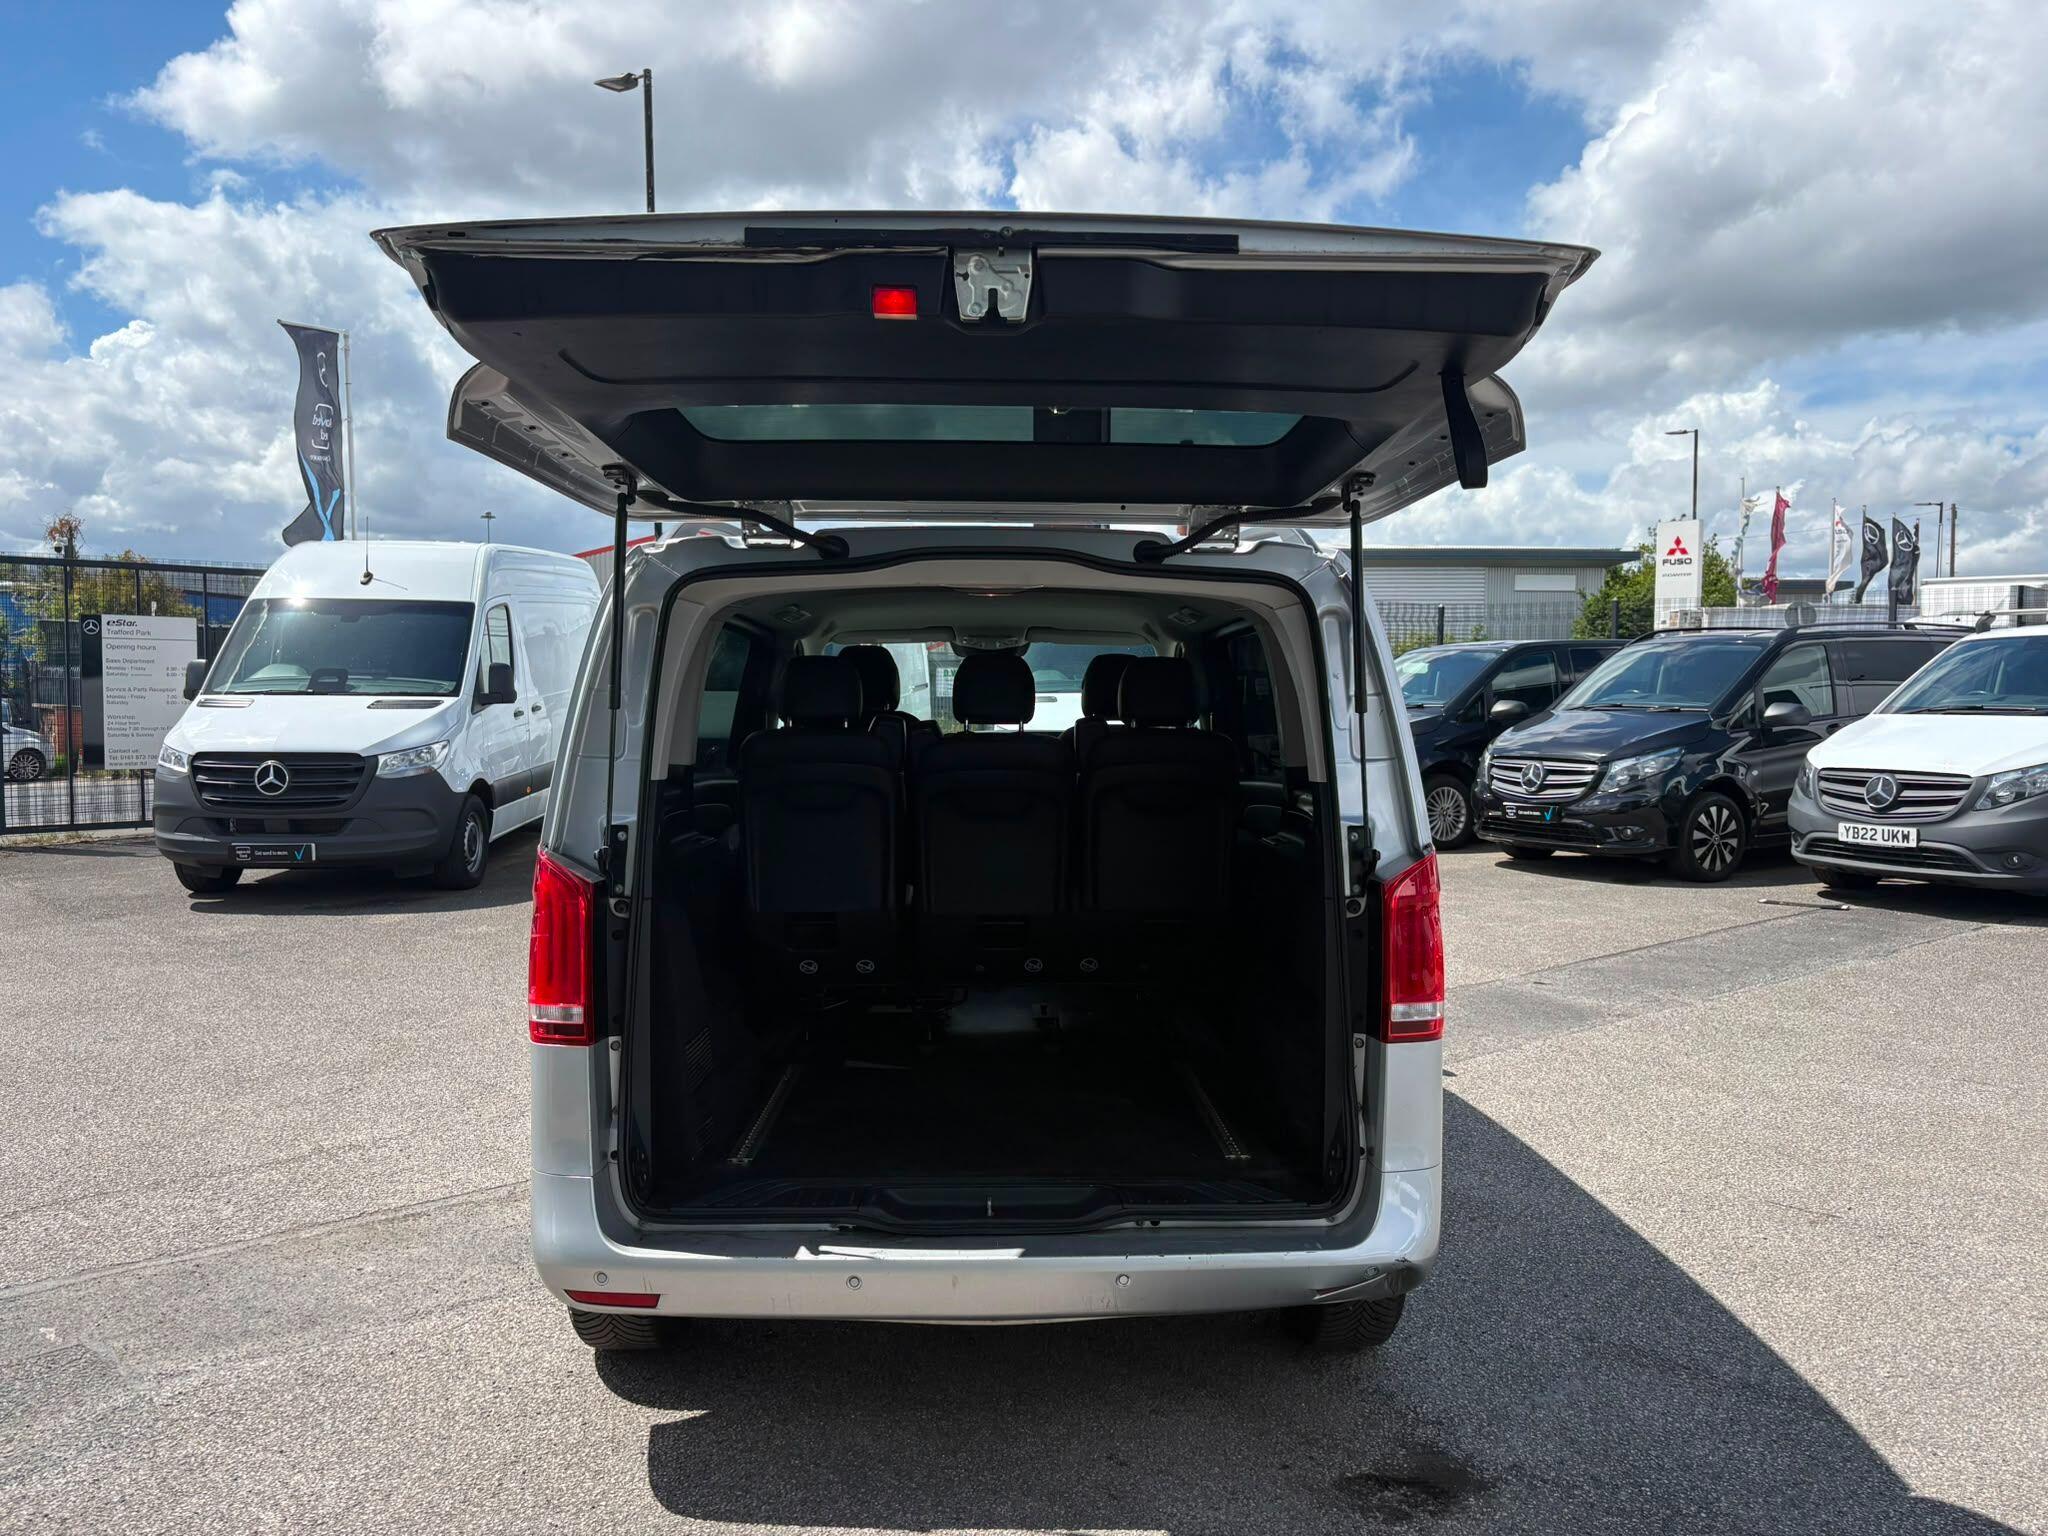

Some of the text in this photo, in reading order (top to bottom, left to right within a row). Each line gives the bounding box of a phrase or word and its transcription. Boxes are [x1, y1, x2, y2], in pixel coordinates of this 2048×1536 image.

[1662, 557, 1692, 566] FUSO
[107, 628, 152, 637] Trafford Park
[105, 643, 157, 651] Opening hours
[1844, 825, 1910, 844] YB22 UKW
